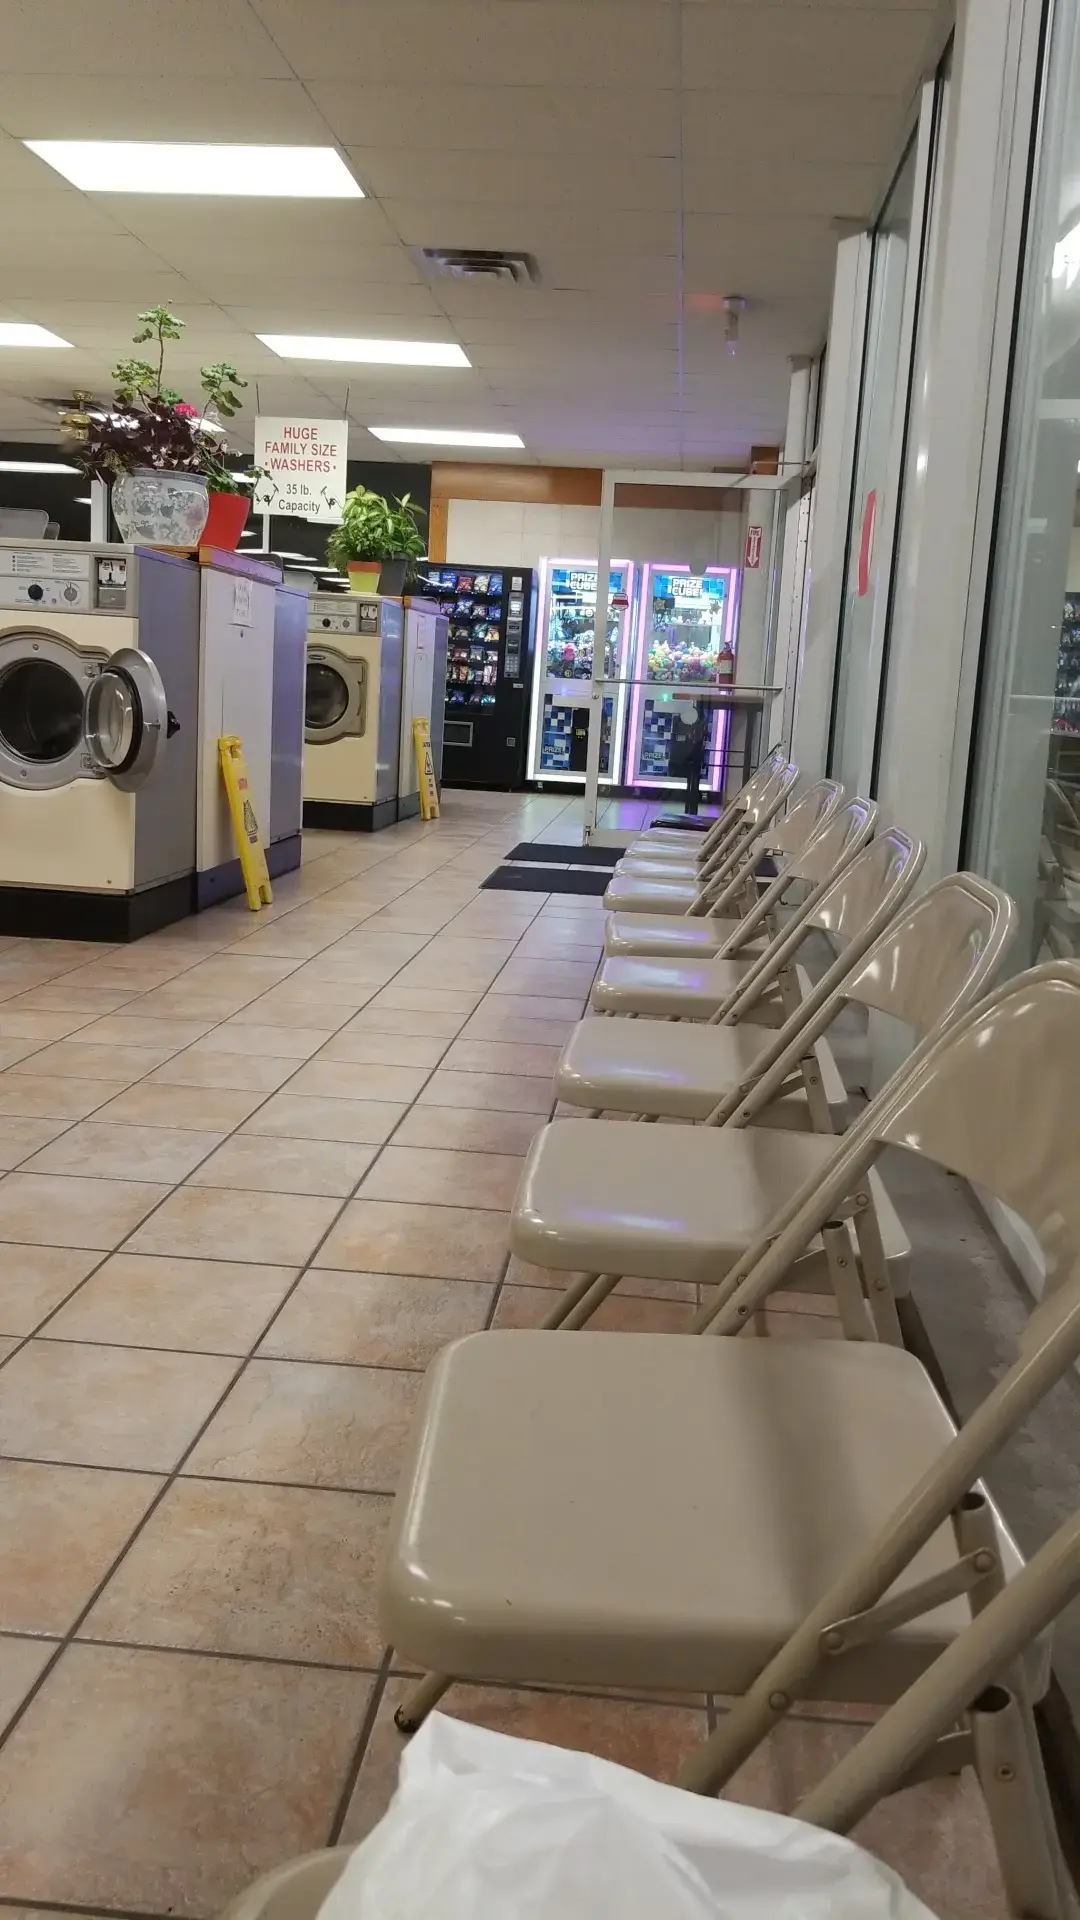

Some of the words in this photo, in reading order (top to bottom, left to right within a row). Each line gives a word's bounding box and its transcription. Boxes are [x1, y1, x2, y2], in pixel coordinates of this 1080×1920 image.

[283, 427, 318, 440] HUGE
[265, 441, 308, 456] FAMILY
[311, 444, 338, 457] SIZE
[270, 458, 331, 473] WASHERS
[286, 483, 298, 495] 35
[300, 484, 312, 495] lb.
[278, 499, 321, 514] Capacity
[672, 578, 703, 588] PRIZE
